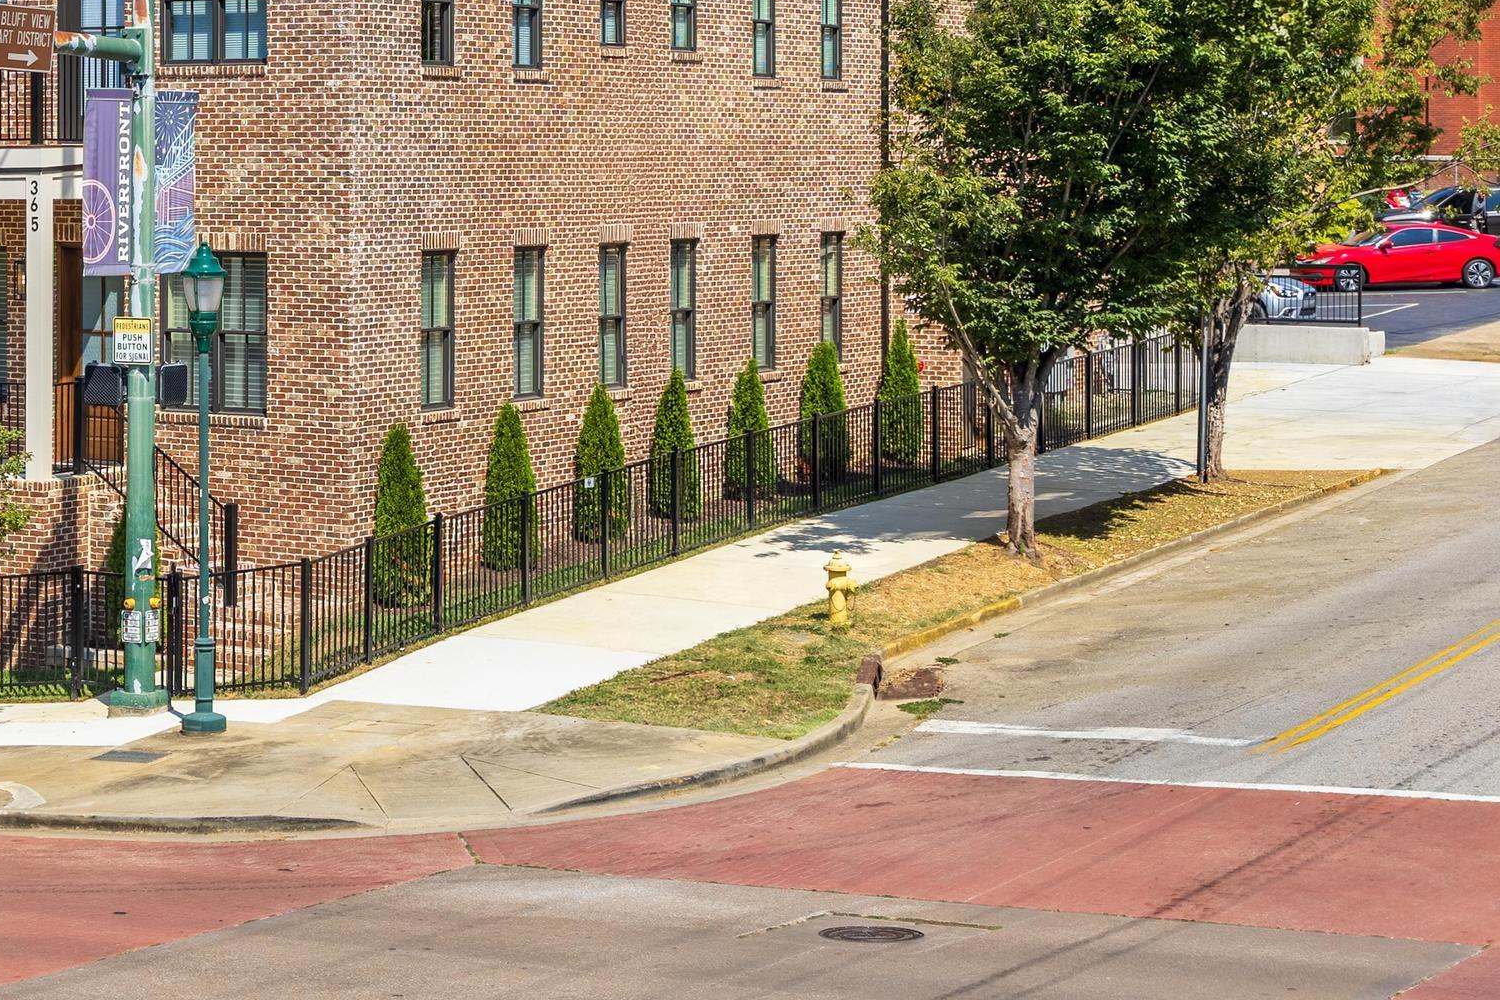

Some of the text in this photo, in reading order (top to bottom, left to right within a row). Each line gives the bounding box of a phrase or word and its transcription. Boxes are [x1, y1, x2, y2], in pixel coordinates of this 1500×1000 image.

[0, 10, 51, 29] BLUFF VIEW
[16, 30, 52, 47] DISTRICT
[117, 101, 131, 263] RIVERFRONT
[30, 180, 39, 232] 365
[115, 322, 149, 331] PEDESTRIANS
[122, 333, 143, 342] PUSH
[116, 342, 148, 351] BUTTON
[115, 351, 149, 361] FOR SIGNAL
